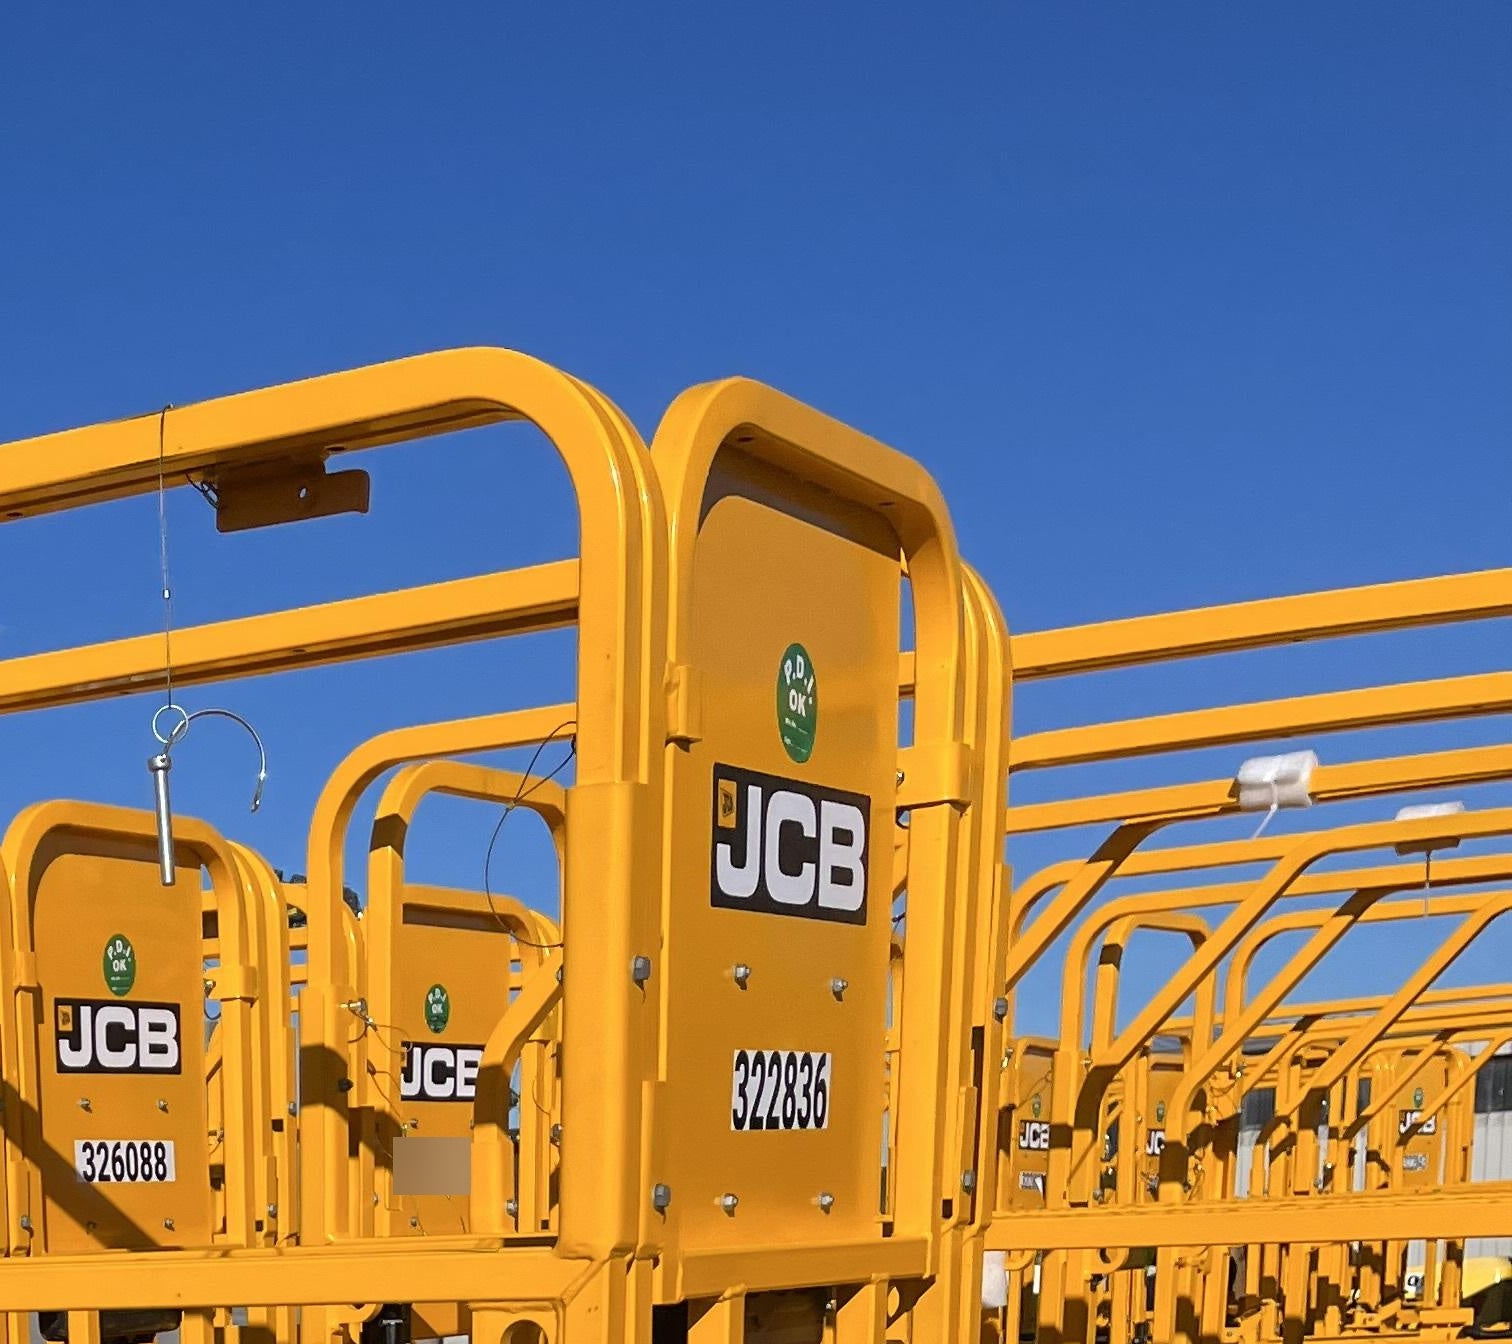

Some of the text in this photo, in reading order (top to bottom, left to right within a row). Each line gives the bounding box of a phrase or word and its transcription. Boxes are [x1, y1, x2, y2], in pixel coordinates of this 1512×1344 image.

[789, 688, 806, 717] OK
[716, 784, 865, 911] JCB
[113, 958, 127, 973] OK
[58, 1005, 179, 1068] JCB
[733, 1050, 827, 1130] 322836
[82, 1141, 168, 1182] 326088
